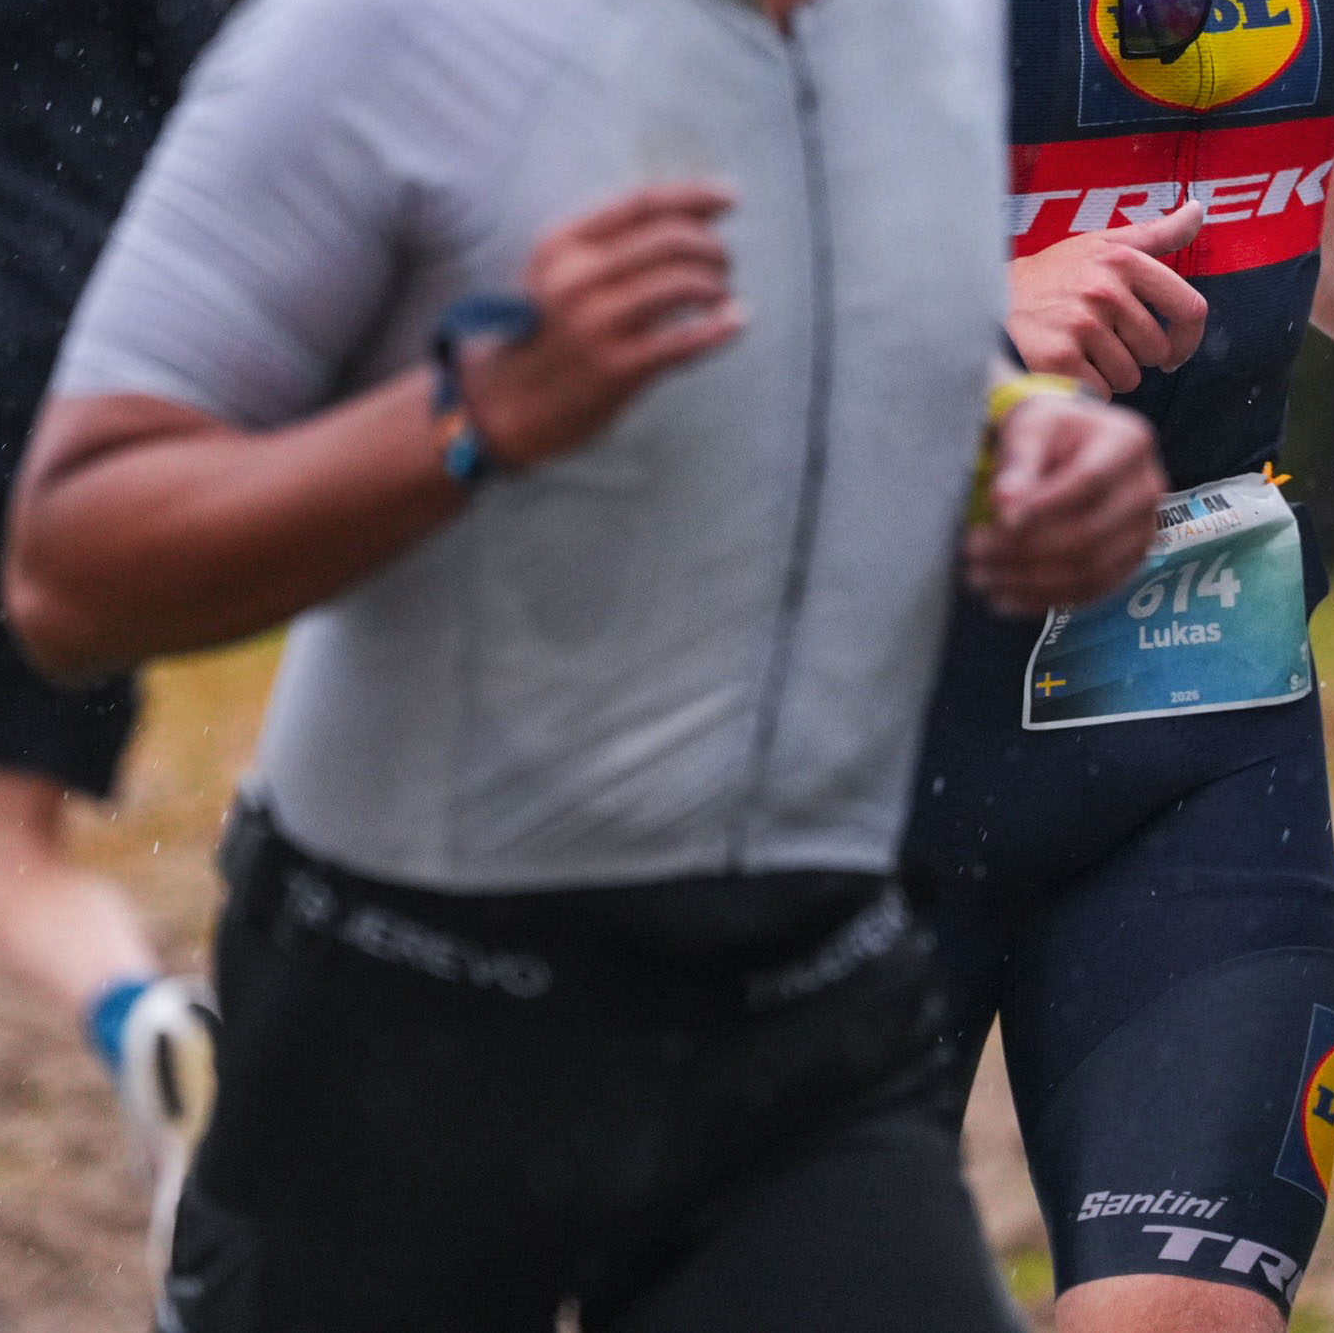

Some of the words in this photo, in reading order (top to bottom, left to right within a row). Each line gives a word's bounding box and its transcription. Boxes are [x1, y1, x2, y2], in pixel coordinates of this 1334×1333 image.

[1127, 551, 1242, 619] 614
[1139, 621, 1222, 650] Lukas
[1077, 1189, 1229, 1221] Santini
